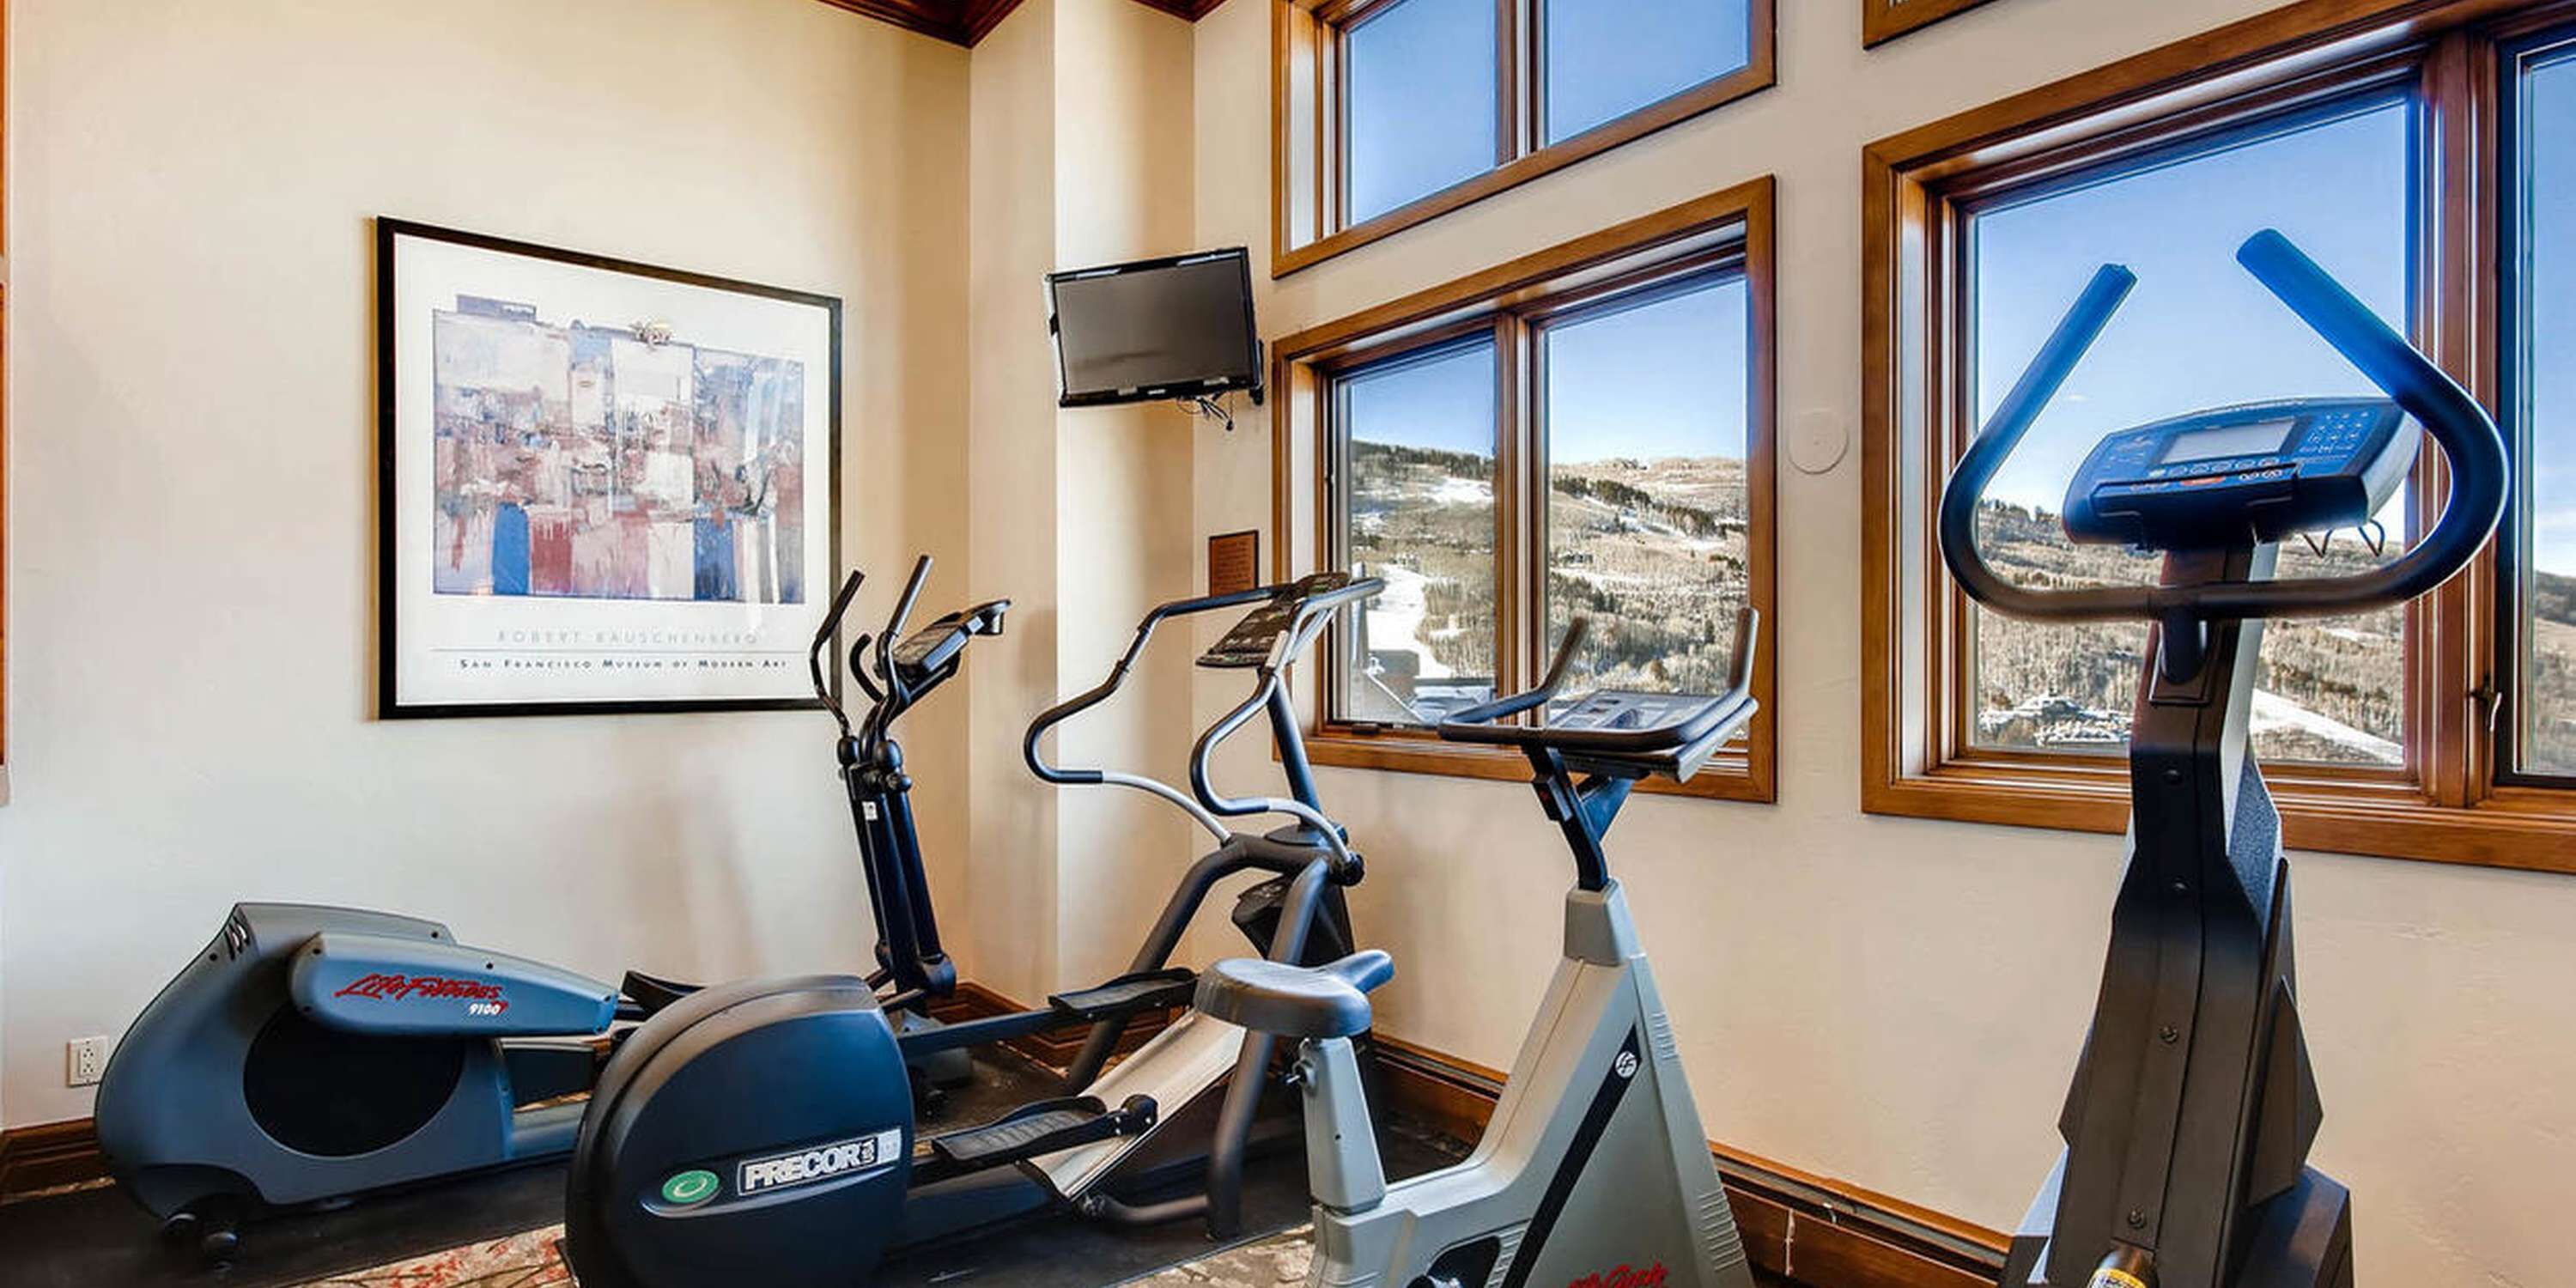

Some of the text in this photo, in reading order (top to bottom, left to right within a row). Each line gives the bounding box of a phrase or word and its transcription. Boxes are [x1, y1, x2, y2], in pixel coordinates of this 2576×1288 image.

[497, 630, 579, 644] ROBERT
[469, 1003, 501, 1017] 9100
[744, 1143, 860, 1190] PRECOR
